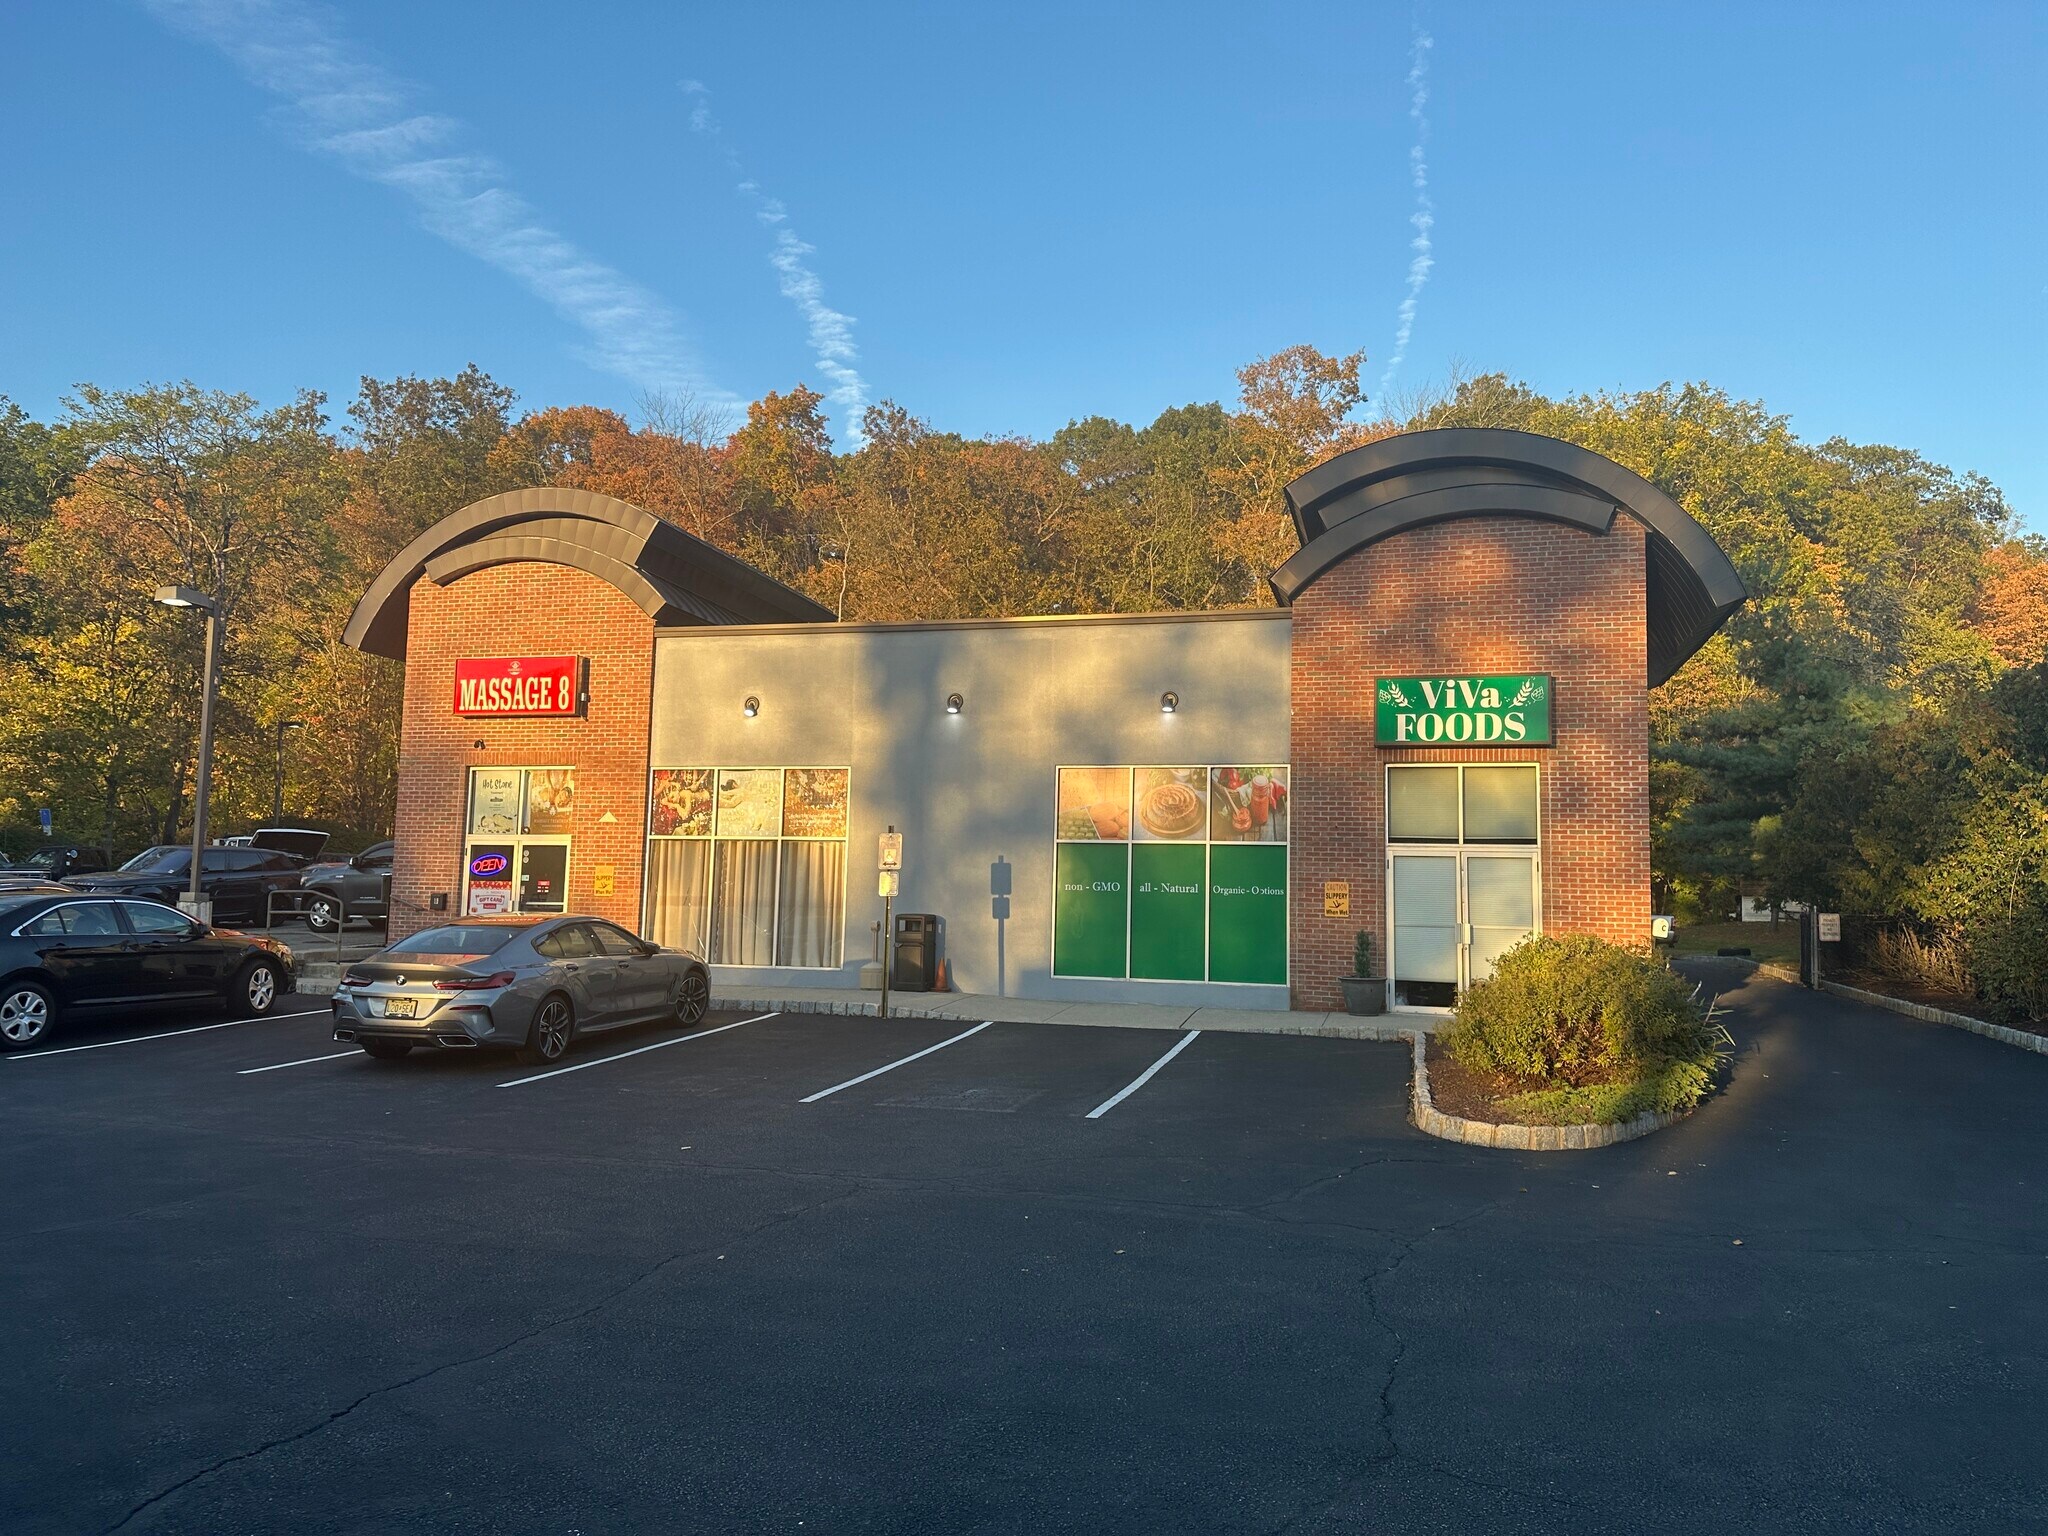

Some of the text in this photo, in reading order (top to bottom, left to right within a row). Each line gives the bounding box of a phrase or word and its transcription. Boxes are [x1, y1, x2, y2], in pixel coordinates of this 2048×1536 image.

[458, 676, 570, 711] MASSAGE 8
[1418, 679, 1503, 709] ViVa
[1395, 711, 1527, 742] FOODS
[482, 778, 513, 790] Hot Stone
[473, 858, 504, 872] OPEN
[1092, 881, 1121, 892] GMO
[1139, 882, 1152, 892] all
[1160, 883, 1199, 893] Natural
[1212, 885, 1246, 897] Organic
[1326, 883, 1347, 891] CAUTION
